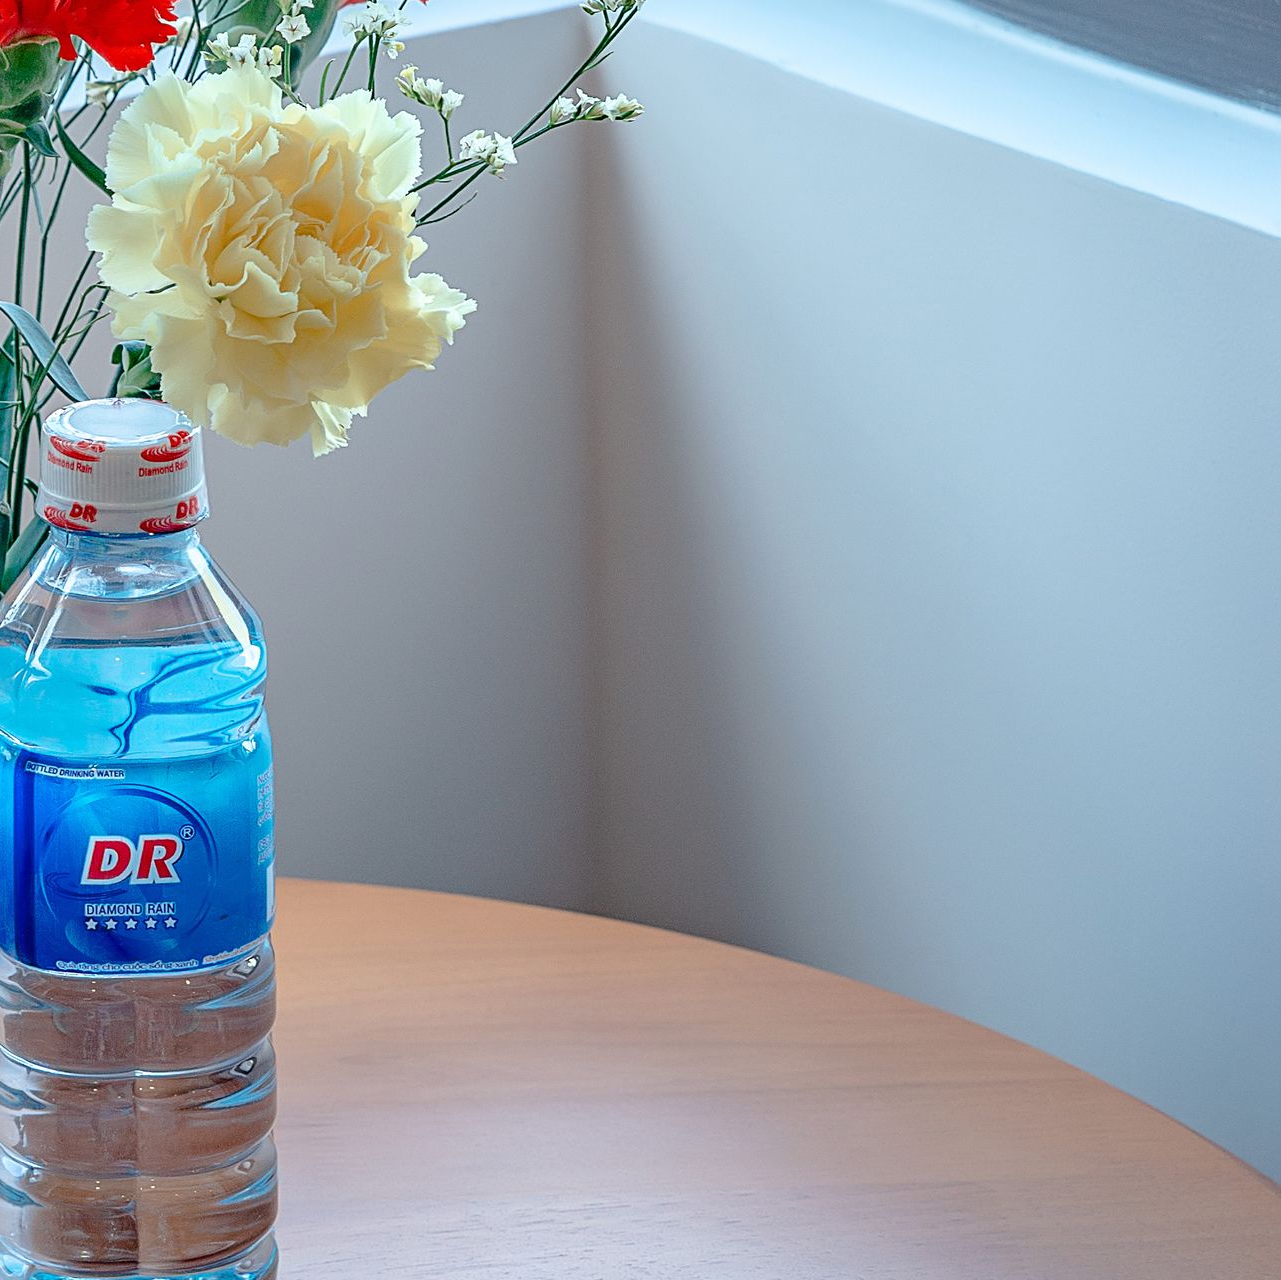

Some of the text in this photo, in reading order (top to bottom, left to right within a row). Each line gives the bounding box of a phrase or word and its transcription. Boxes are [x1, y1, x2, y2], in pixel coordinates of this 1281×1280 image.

[138, 462, 174, 477] Diamond
[69, 502, 98, 523] DR
[175, 495, 199, 520] DR
[25, 761, 125, 778] BOTTLED DRINKING WATER
[81, 834, 181, 885] DR
[85, 902, 176, 916] DIAMOND RAIN
